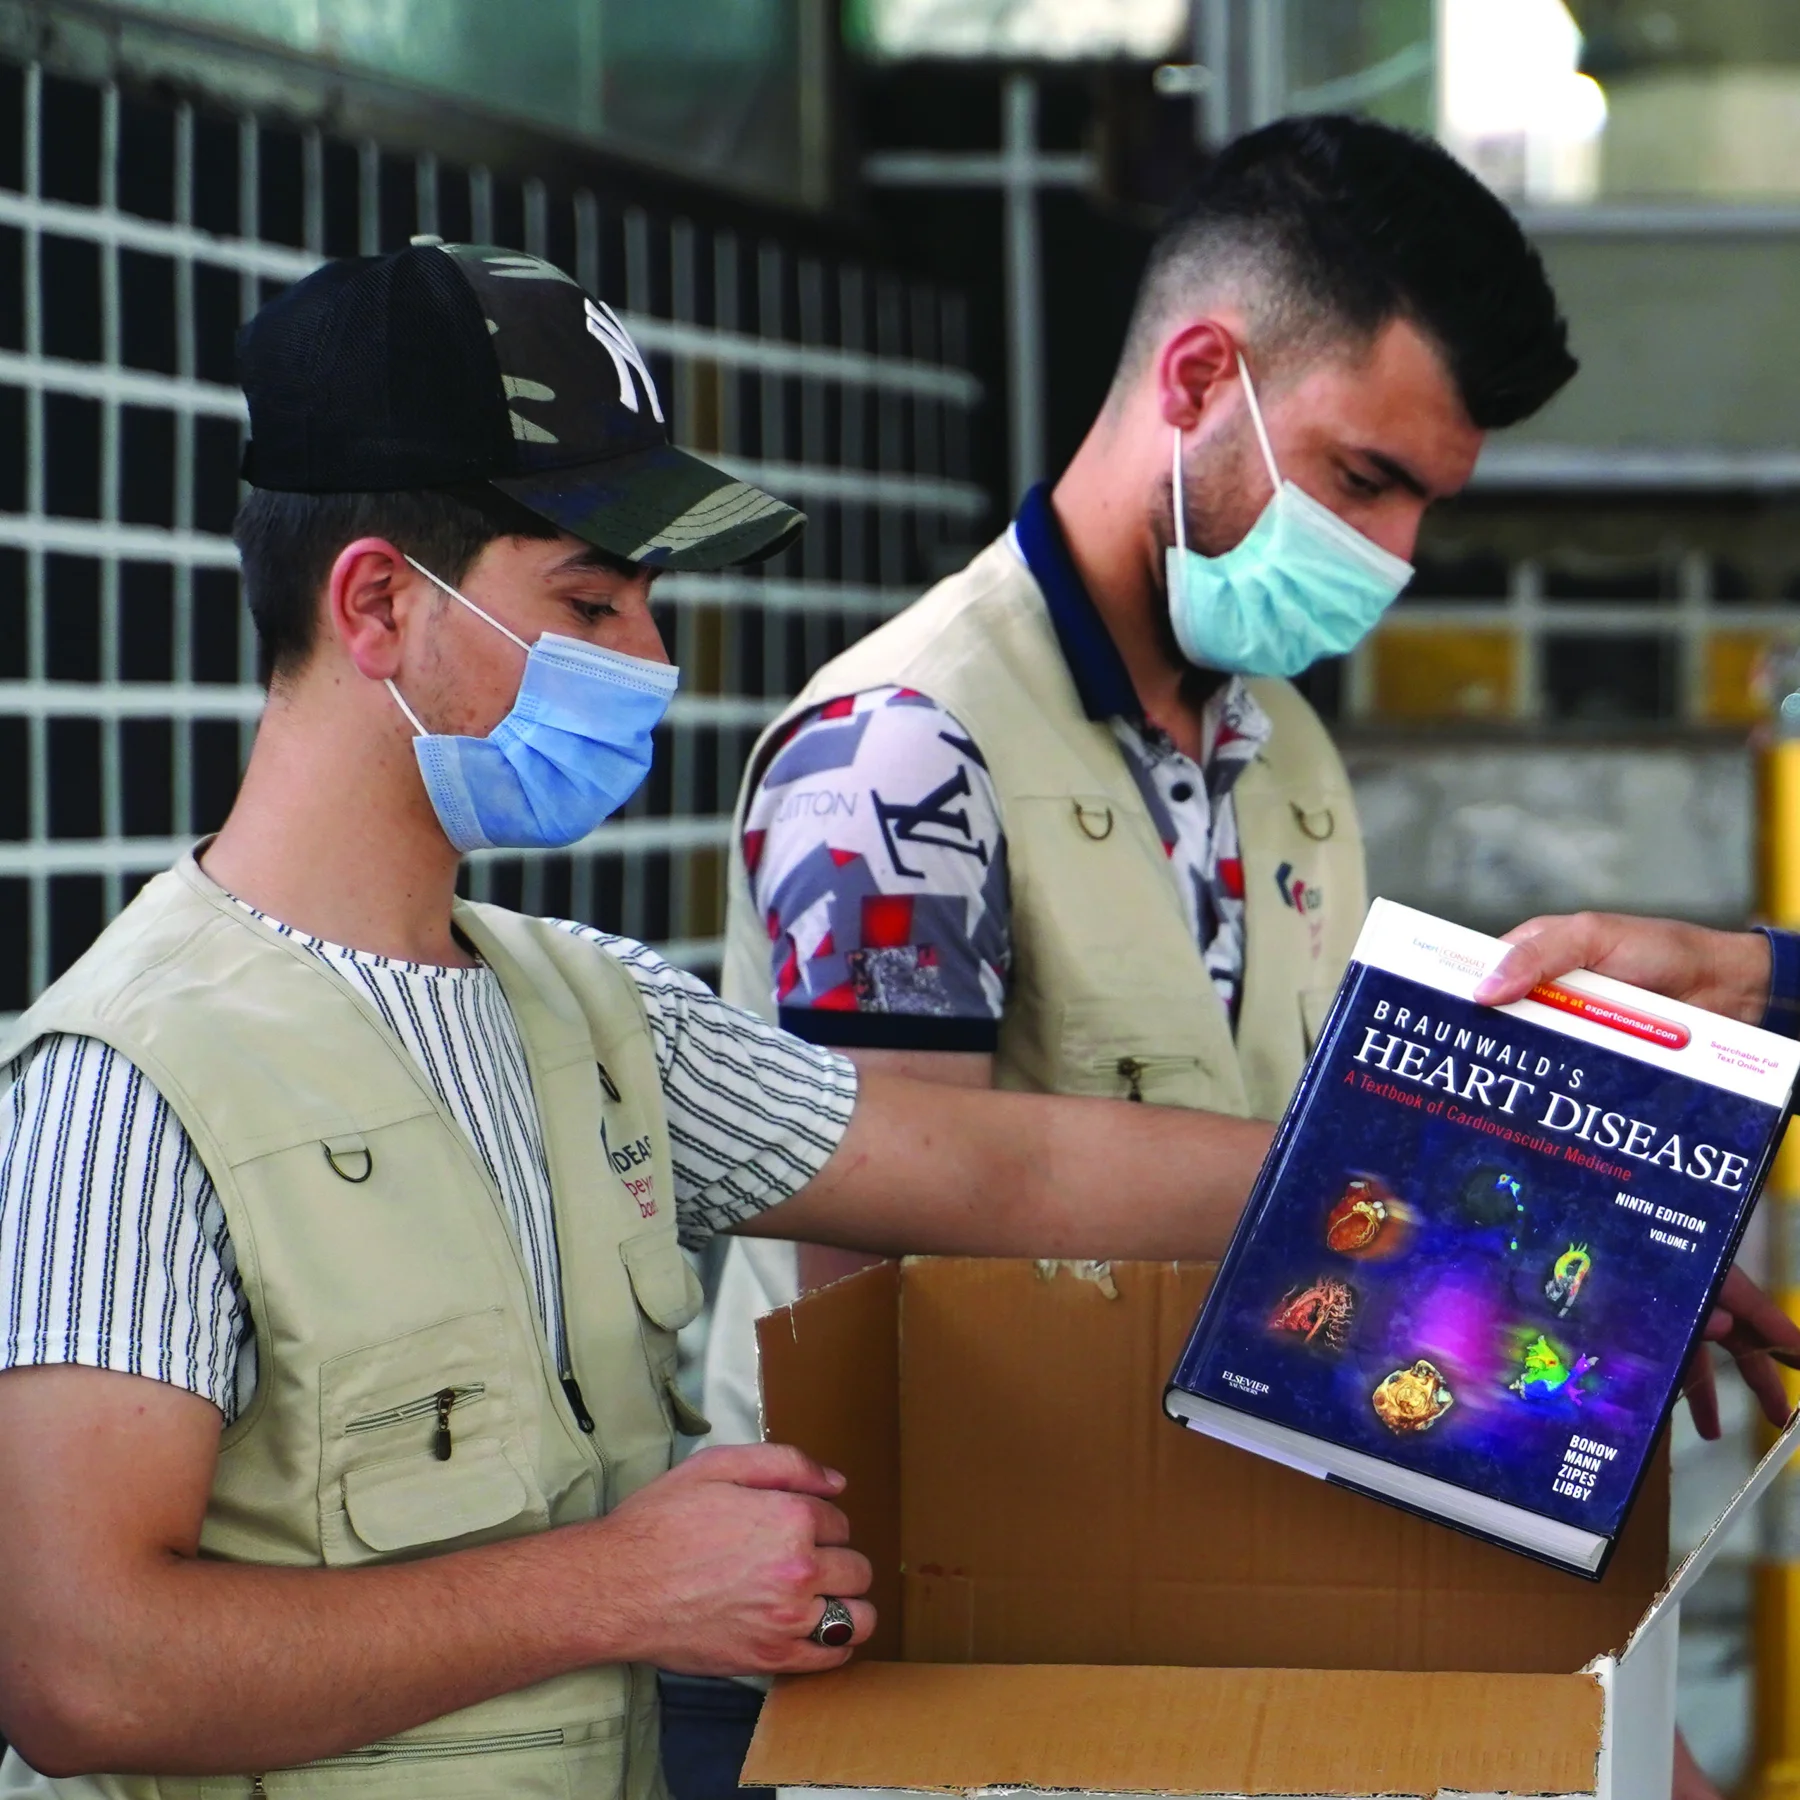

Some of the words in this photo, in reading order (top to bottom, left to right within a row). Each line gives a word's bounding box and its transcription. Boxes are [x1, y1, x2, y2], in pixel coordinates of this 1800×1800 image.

[1570, 998, 1584, 1009] at
[1584, 1004, 1678, 1042] expertconsult.com
[1373, 1000, 1584, 1089] BRAUNWALD'S
[1710, 1040, 1760, 1063] Searchable
[1762, 1057, 1779, 1069] Full
[1717, 1052, 1735, 1065] Text
[1737, 1059, 1765, 1075] Online
[1353, 1026, 1535, 1115] HEART
[1537, 1091, 1749, 1192] DISEASE
[1344, 1070, 1355, 1085] A
[1359, 1073, 1424, 1109] Textbook
[1426, 1099, 1444, 1116] of
[1446, 1105, 1561, 1158] Cardiovascular
[1563, 1145, 1632, 1182] Medicine
[1615, 1191, 1654, 1216] NINTH
[1655, 1205, 1707, 1234] EDITION
[1649, 1228, 1689, 1251] VOLUME
[1690, 1242, 1697, 1253] 1
[1222, 1370, 1269, 1394] ELSEVIER
[1563, 1449, 1601, 1473] MANN
[1569, 1434, 1618, 1461] BONOW
[1557, 1463, 1597, 1487] ZIPES
[1552, 1478, 1592, 1502] LIBBY
